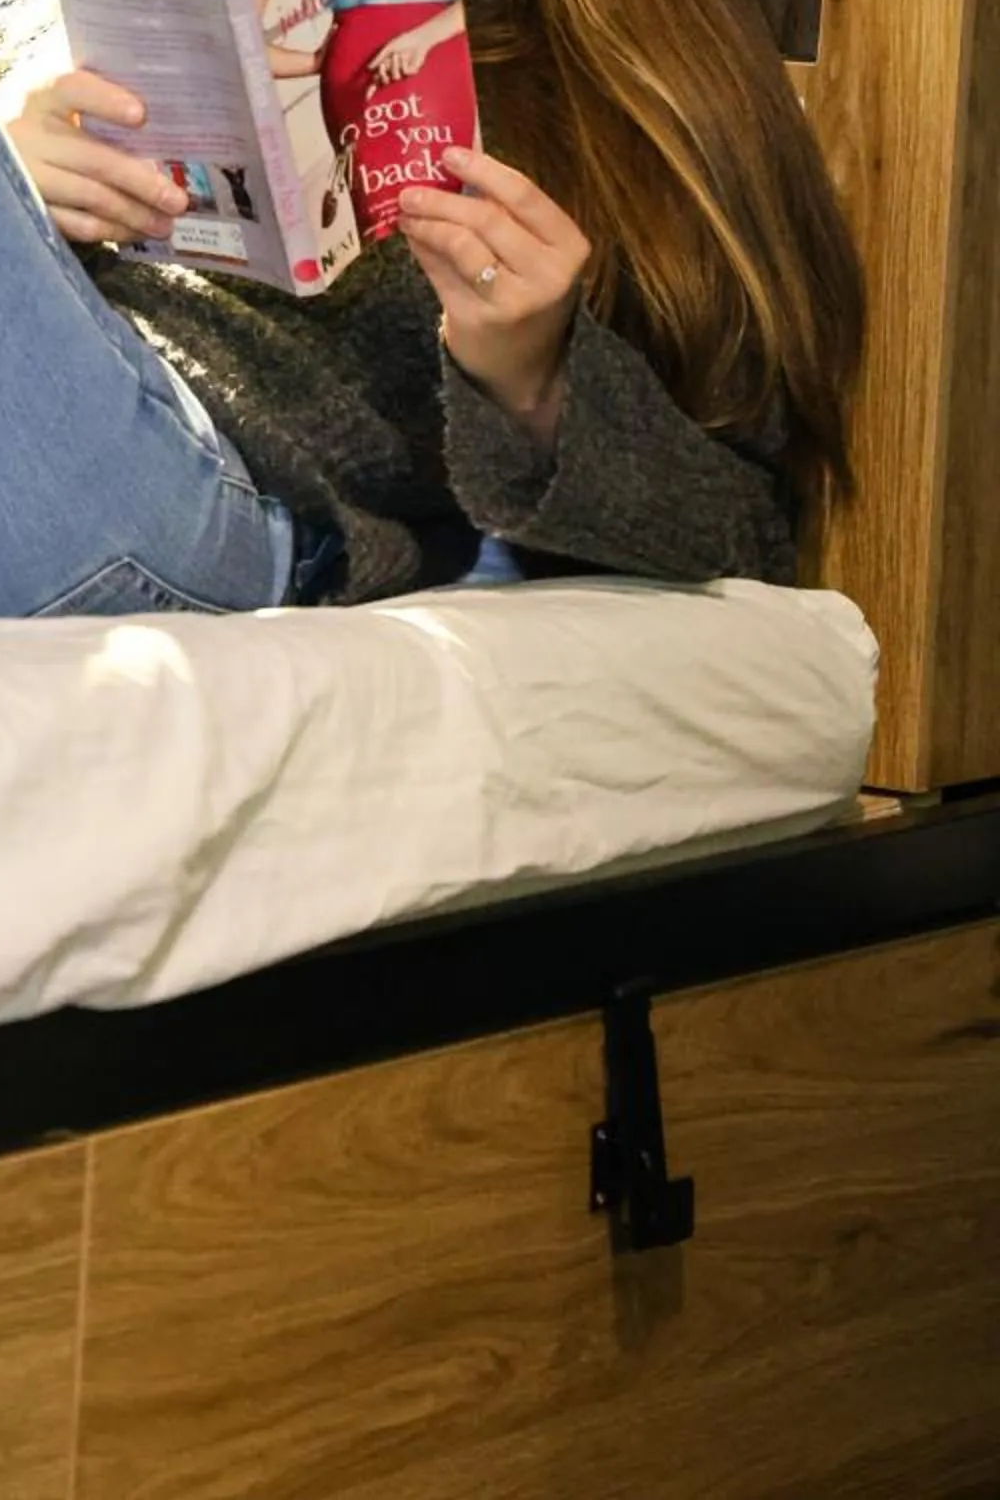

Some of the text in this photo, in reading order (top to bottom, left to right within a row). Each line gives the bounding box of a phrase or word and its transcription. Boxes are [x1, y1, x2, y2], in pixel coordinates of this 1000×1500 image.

[363, 92, 424, 138] got
[395, 124, 454, 155] you
[359, 148, 448, 194] back
